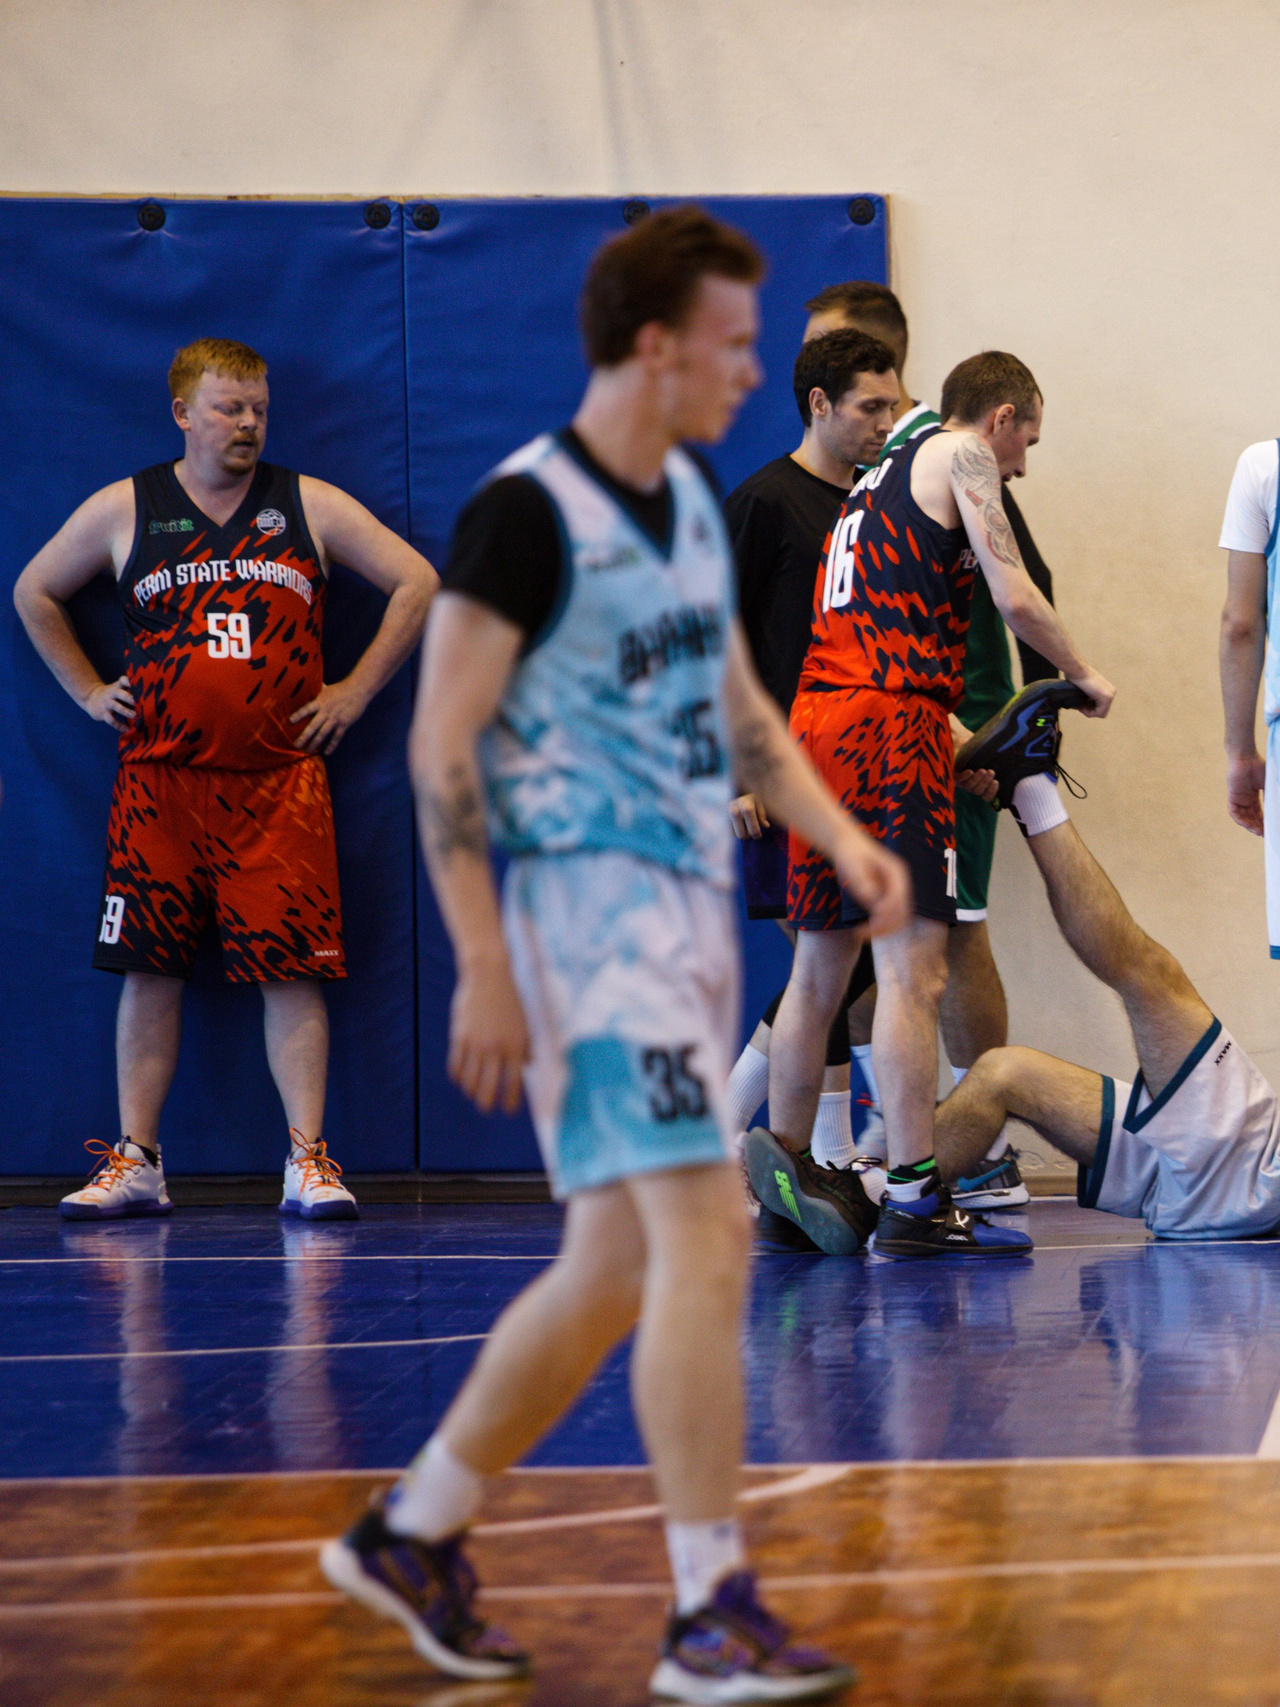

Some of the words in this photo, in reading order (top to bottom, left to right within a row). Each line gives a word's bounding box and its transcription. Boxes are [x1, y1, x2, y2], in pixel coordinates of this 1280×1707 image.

[133, 568, 172, 607] PERM
[176, 559, 231, 586] STATE
[235, 559, 313, 606] WARRIORS
[823, 510, 864, 613] 16
[207, 613, 251, 659] 59
[642, 1042, 709, 1123] 35
